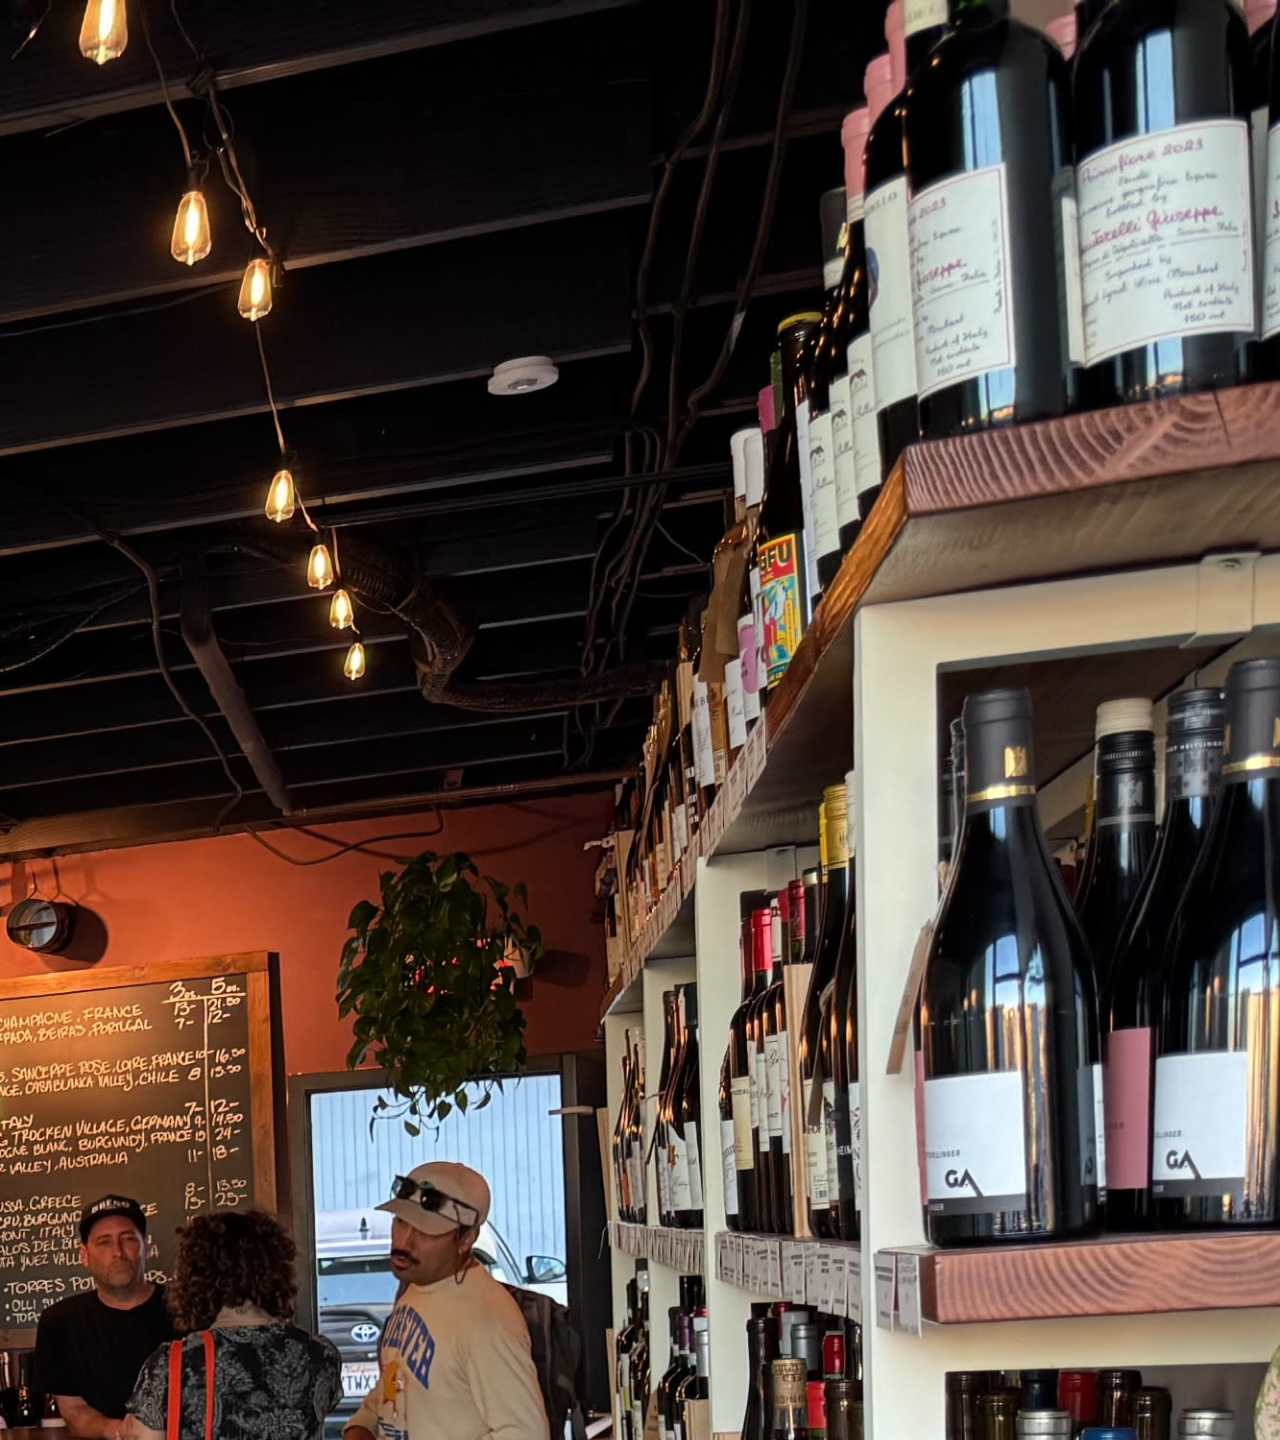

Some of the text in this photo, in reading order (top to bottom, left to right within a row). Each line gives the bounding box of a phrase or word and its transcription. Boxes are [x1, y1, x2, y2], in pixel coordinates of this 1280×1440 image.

[83, 1004, 143, 1021] FRANCE
[140, 1070, 180, 1084] CHILE
[29, 1195, 81, 1210] GREECE
[40, 1224, 75, 1238] ITALY
[7, 1279, 65, 1295] TORRES
